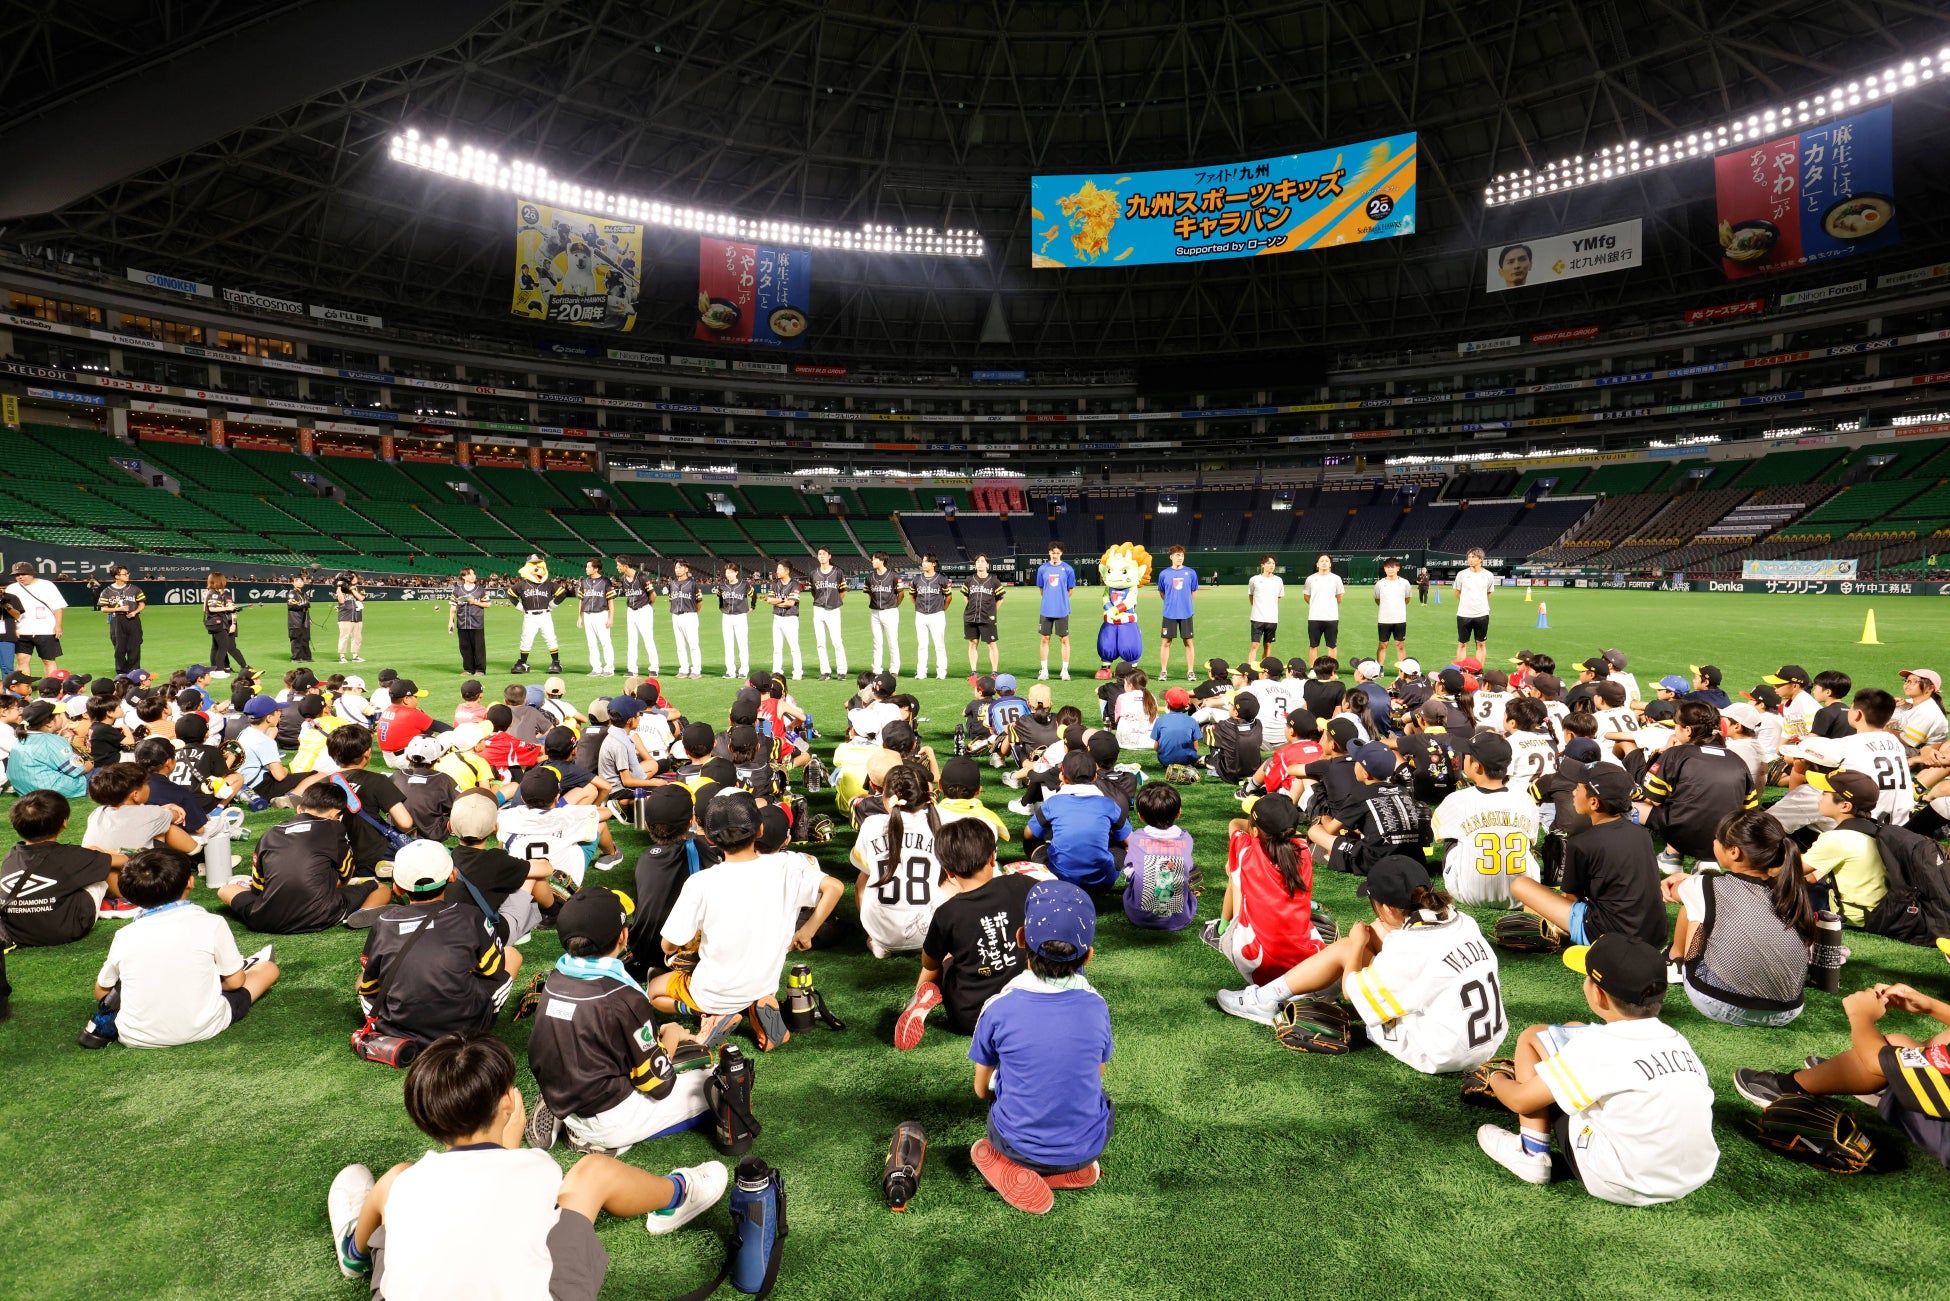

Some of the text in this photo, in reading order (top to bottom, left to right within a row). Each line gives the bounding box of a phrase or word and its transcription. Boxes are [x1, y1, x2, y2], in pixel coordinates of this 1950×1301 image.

[1750, 150, 1769, 188] ある。
[1832, 123, 1853, 199] 麻生には、
[1770, 139, 1796, 220] 「やわ」が
[1802, 130, 1830, 213] 「カタ」と
[1126, 169, 1347, 219] 九州スポーツキッズ
[1173, 205, 1292, 240] キャラバン
[1176, 235, 1288, 256] Supported by ローソン
[1572, 233, 1616, 254] YMfg
[725, 245, 738, 277] ある。
[1569, 247, 1633, 271] 北九州銀行
[157, 275, 197, 293] ONOKEN
[738, 247, 756, 305] 「やわ」が
[758, 250, 776, 309] 「カタ」と
[776, 252, 790, 308] 麻生には、
[223, 289, 303, 314] transcosmos
[1797, 283, 1862, 301] Nihon Forest
[356, 314, 369, 323] BE
[1706, 302, 1758, 317] ケーズデンキ
[119, 336, 156, 348] NEOMARS
[1832, 340, 1892, 356] SCSK SCSK
[640, 354, 663, 363] Forest
[102, 378, 163, 394] リョーユーパン
[475, 387, 496, 395] OKI
[57, 392, 101, 405] テラスカイ
[1760, 394, 1786, 403] TOTO
[1578, 453, 1627, 462] CHIKYUJIN
[60, 561, 115, 575] ニシイ
[1709, 581, 1744, 592] Denka
[1765, 581, 1828, 594] サニクリーン
[1855, 583, 1912, 594] 竹中工務店
[999, 707, 1020, 726] 16
[1479, 701, 1493, 719] 3
[379, 721, 389, 742] 7
[1609, 714, 1638, 733] 18
[1866, 739, 1902, 754] WADA
[1873, 756, 1907, 791] 21
[870, 832, 933, 856] KIURA
[1474, 832, 1528, 876] 32
[7, 905, 54, 914] INTERNATIONAL
[49, 896, 57, 904] IS
[979, 916, 1004, 971] 生きさせて
[993, 911, 1017, 967] ボーッと
[1441, 939, 1489, 976] WADA
[1460, 970, 1505, 1051] 21
